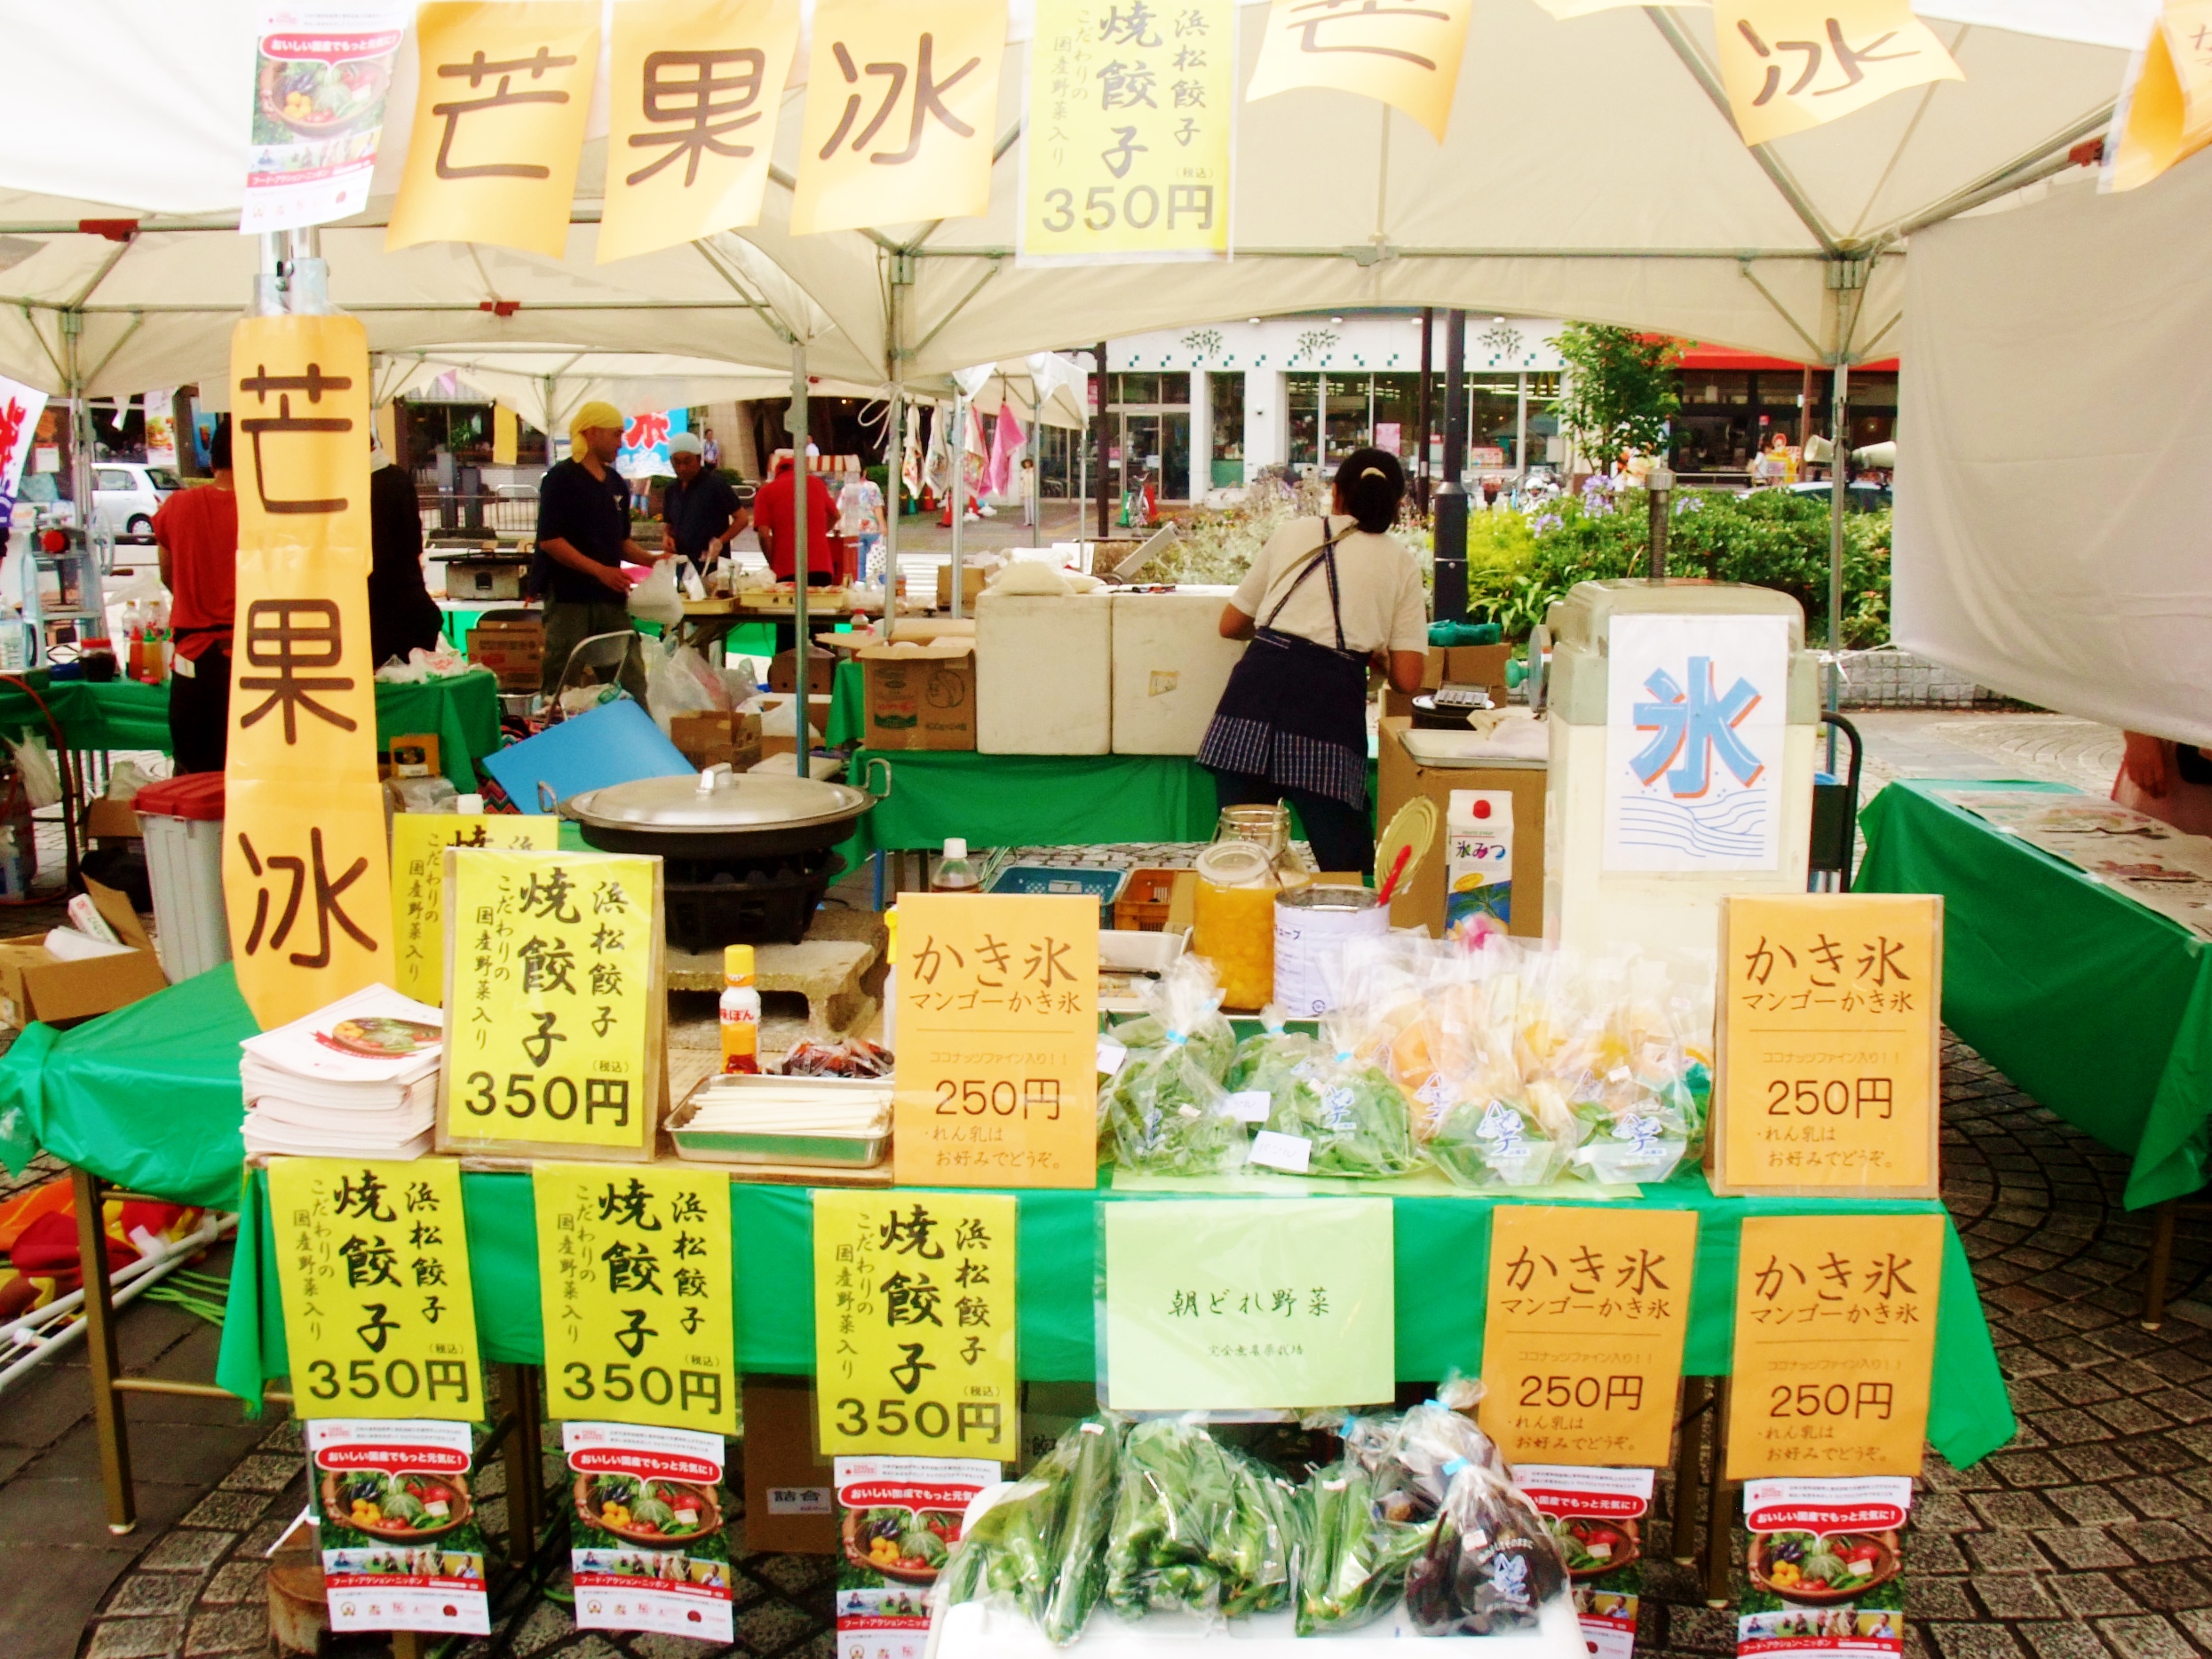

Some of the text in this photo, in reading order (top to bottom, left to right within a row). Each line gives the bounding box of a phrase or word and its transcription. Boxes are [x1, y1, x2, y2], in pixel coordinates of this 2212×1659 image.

[1632, 655, 1763, 799] 氷
[425, 832, 442, 925] こだわりの
[1455, 840, 1507, 861] 氷みつ
[405, 859, 424, 982] 国産野菜入り
[495, 874, 515, 982] こだわりの
[588, 880, 630, 1037] 浜松餃子
[911, 933, 1079, 989] かき氷
[1744, 933, 1912, 988] かき氷
[472, 906, 495, 1051] 国産野菜入り
[517, 867, 583, 1068] 焼餃子
[908, 989, 1082, 1015] マンゴーかき氷
[1741, 988, 1915, 1013] マンゴーかき氷
[464, 1072, 630, 1127] 350円
[934, 1078, 1061, 1122] 250円
[1767, 1077, 1893, 1120] 250円
[311, 1179, 336, 1279] こだわりの
[333, 1169, 403, 1354] 焼餃子
[403, 1179, 448, 1325] 浜松餃子
[575, 1185, 597, 1283] こだわりの
[598, 1178, 663, 1358] 焼餃子
[670, 1191, 710, 1336] 浜松餃子
[856, 1211, 876, 1316] こだわりの
[1505, 1244, 1671, 1297] かき氷
[293, 1209, 325, 1343] 国産野菜入り
[557, 1213, 583, 1345] 国産野菜入り
[836, 1243, 859, 1380] 国産野菜入り
[879, 1203, 945, 1393] 焼餃子
[955, 1218, 994, 1366] 浜松餃子
[1168, 1286, 1332, 1319] 朝どれ野菜
[1499, 1295, 1671, 1321] マンゴーかき氷
[1748, 1301, 1920, 1326] マンゴーかき氷
[1754, 1251, 1920, 1301] かき氷
[307, 1360, 470, 1403] 350円
[562, 1361, 723, 1415] 350円
[836, 1398, 1002, 1446] 350円
[1518, 1374, 1644, 1411] 250円
[1770, 1380, 1894, 1421] 250円
